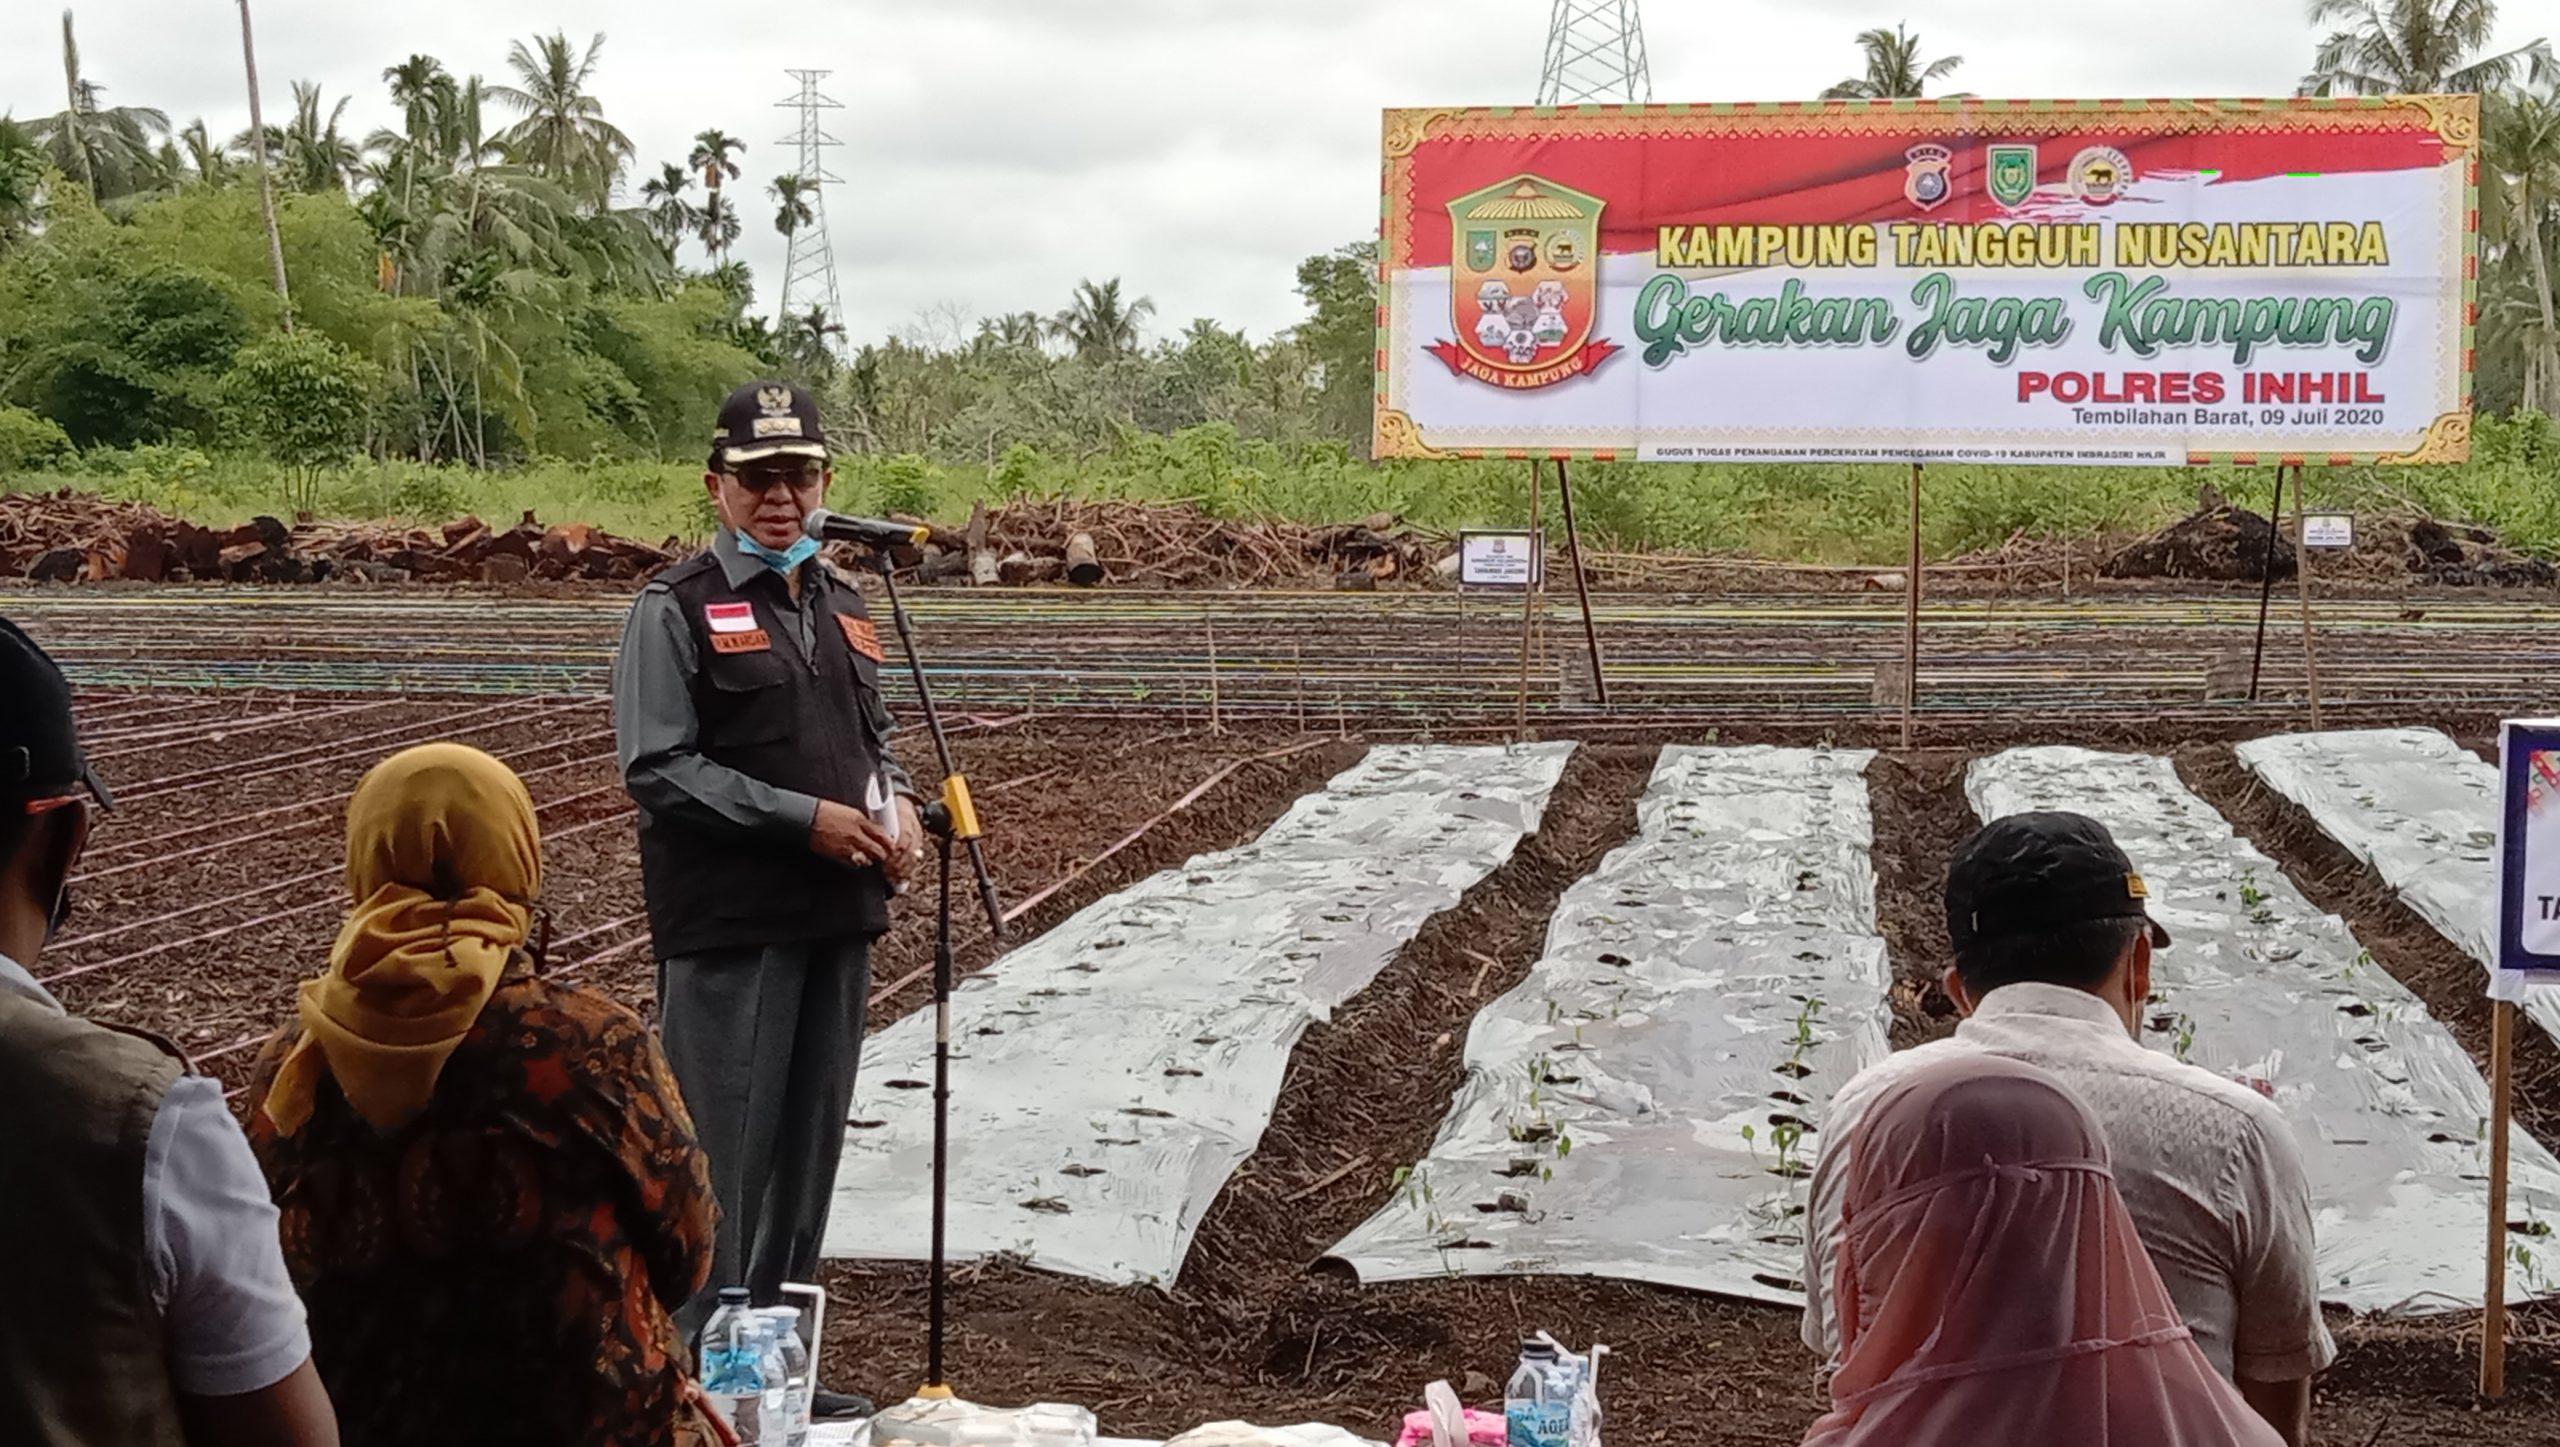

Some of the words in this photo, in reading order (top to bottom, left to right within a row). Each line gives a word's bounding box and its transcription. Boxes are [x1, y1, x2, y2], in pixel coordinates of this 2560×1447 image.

[1657, 223, 1877, 267] KAMPUNG
[1889, 222, 2101, 267] TANGGUH
[2115, 221, 2389, 267] NUSANTARA
[1633, 273, 1899, 367] Gerakan
[1906, 271, 2070, 363] Jaga
[2083, 270, 2395, 365] Kampung
[1461, 358, 1500, 384] JAGA
[1504, 357, 1583, 387] KAMPUNG
[2017, 371, 2225, 403] POLRES
[2242, 372, 2385, 404] INHIL
[2072, 407, 2188, 425] Tembilahan
[2194, 408, 2254, 428] Barat,
[2260, 409, 2285, 425] 09
[2290, 408, 2328, 425] Juli
[2334, 409, 2384, 426] 2020
[1656, 448, 1694, 457] GUGUS
[1697, 448, 1732, 457] TUGAS
[1734, 448, 1807, 457] PENANGANAN
[1810, 448, 1878, 457] PERCEPATAN
[1881, 449, 1954, 458] PENCEGAHAN
[1956, 449, 2007, 459] COVID-19
[2010, 450, 2074, 459] KABUPATEN
